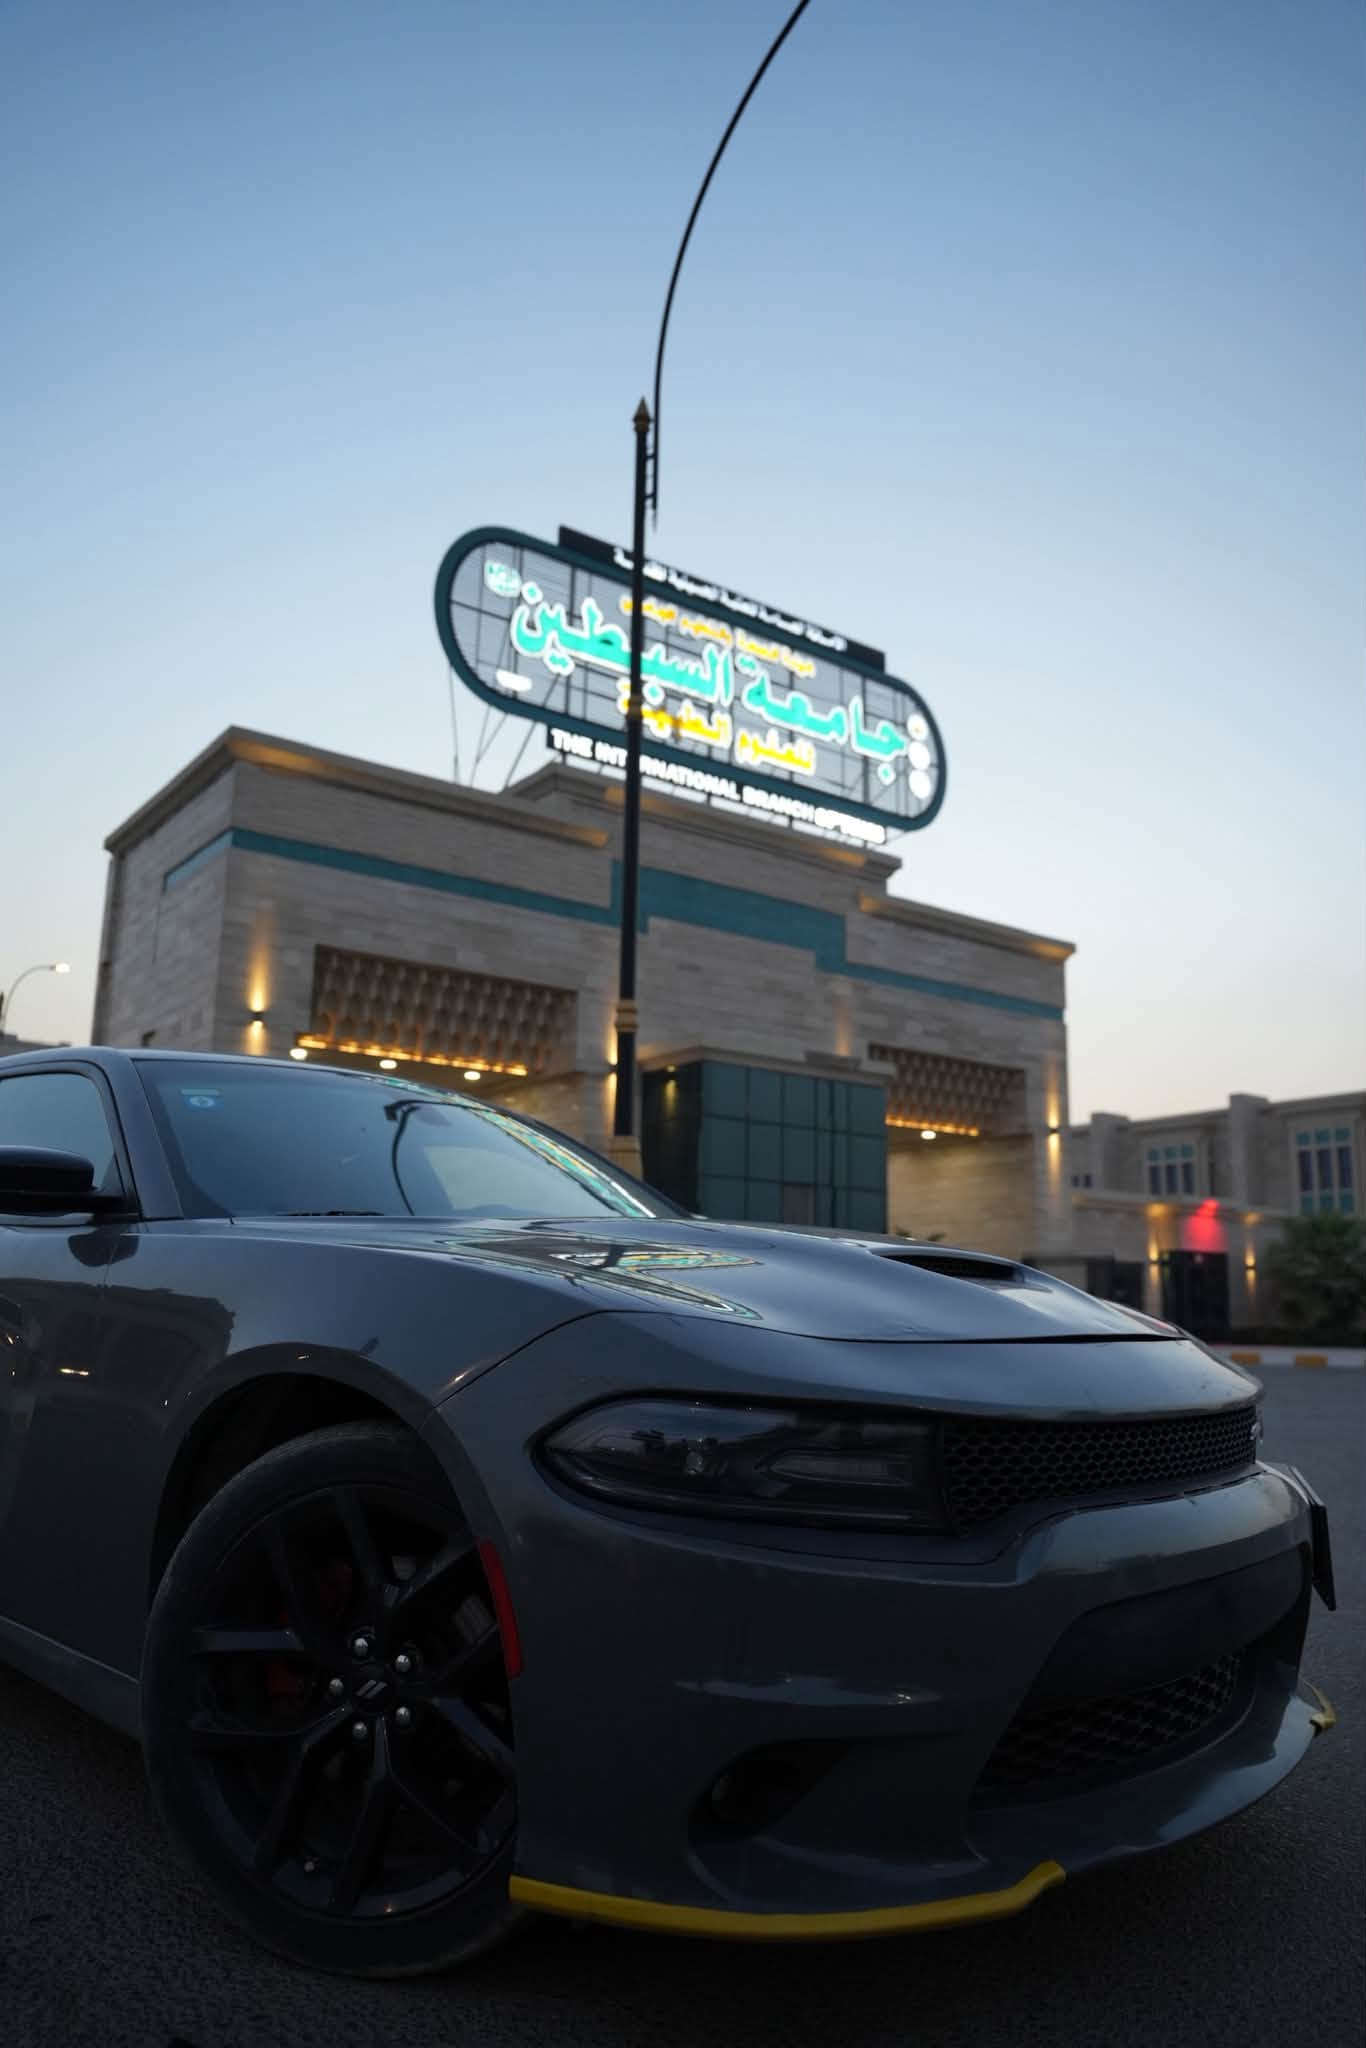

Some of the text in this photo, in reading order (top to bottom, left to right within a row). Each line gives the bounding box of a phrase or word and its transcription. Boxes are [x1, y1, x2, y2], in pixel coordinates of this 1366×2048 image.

[510, 581, 731, 706] السبطين
[551, 729, 593, 758] THE
[595, 741, 740, 800] INTRNATIONAL
[736, 652, 906, 785] جامعة
